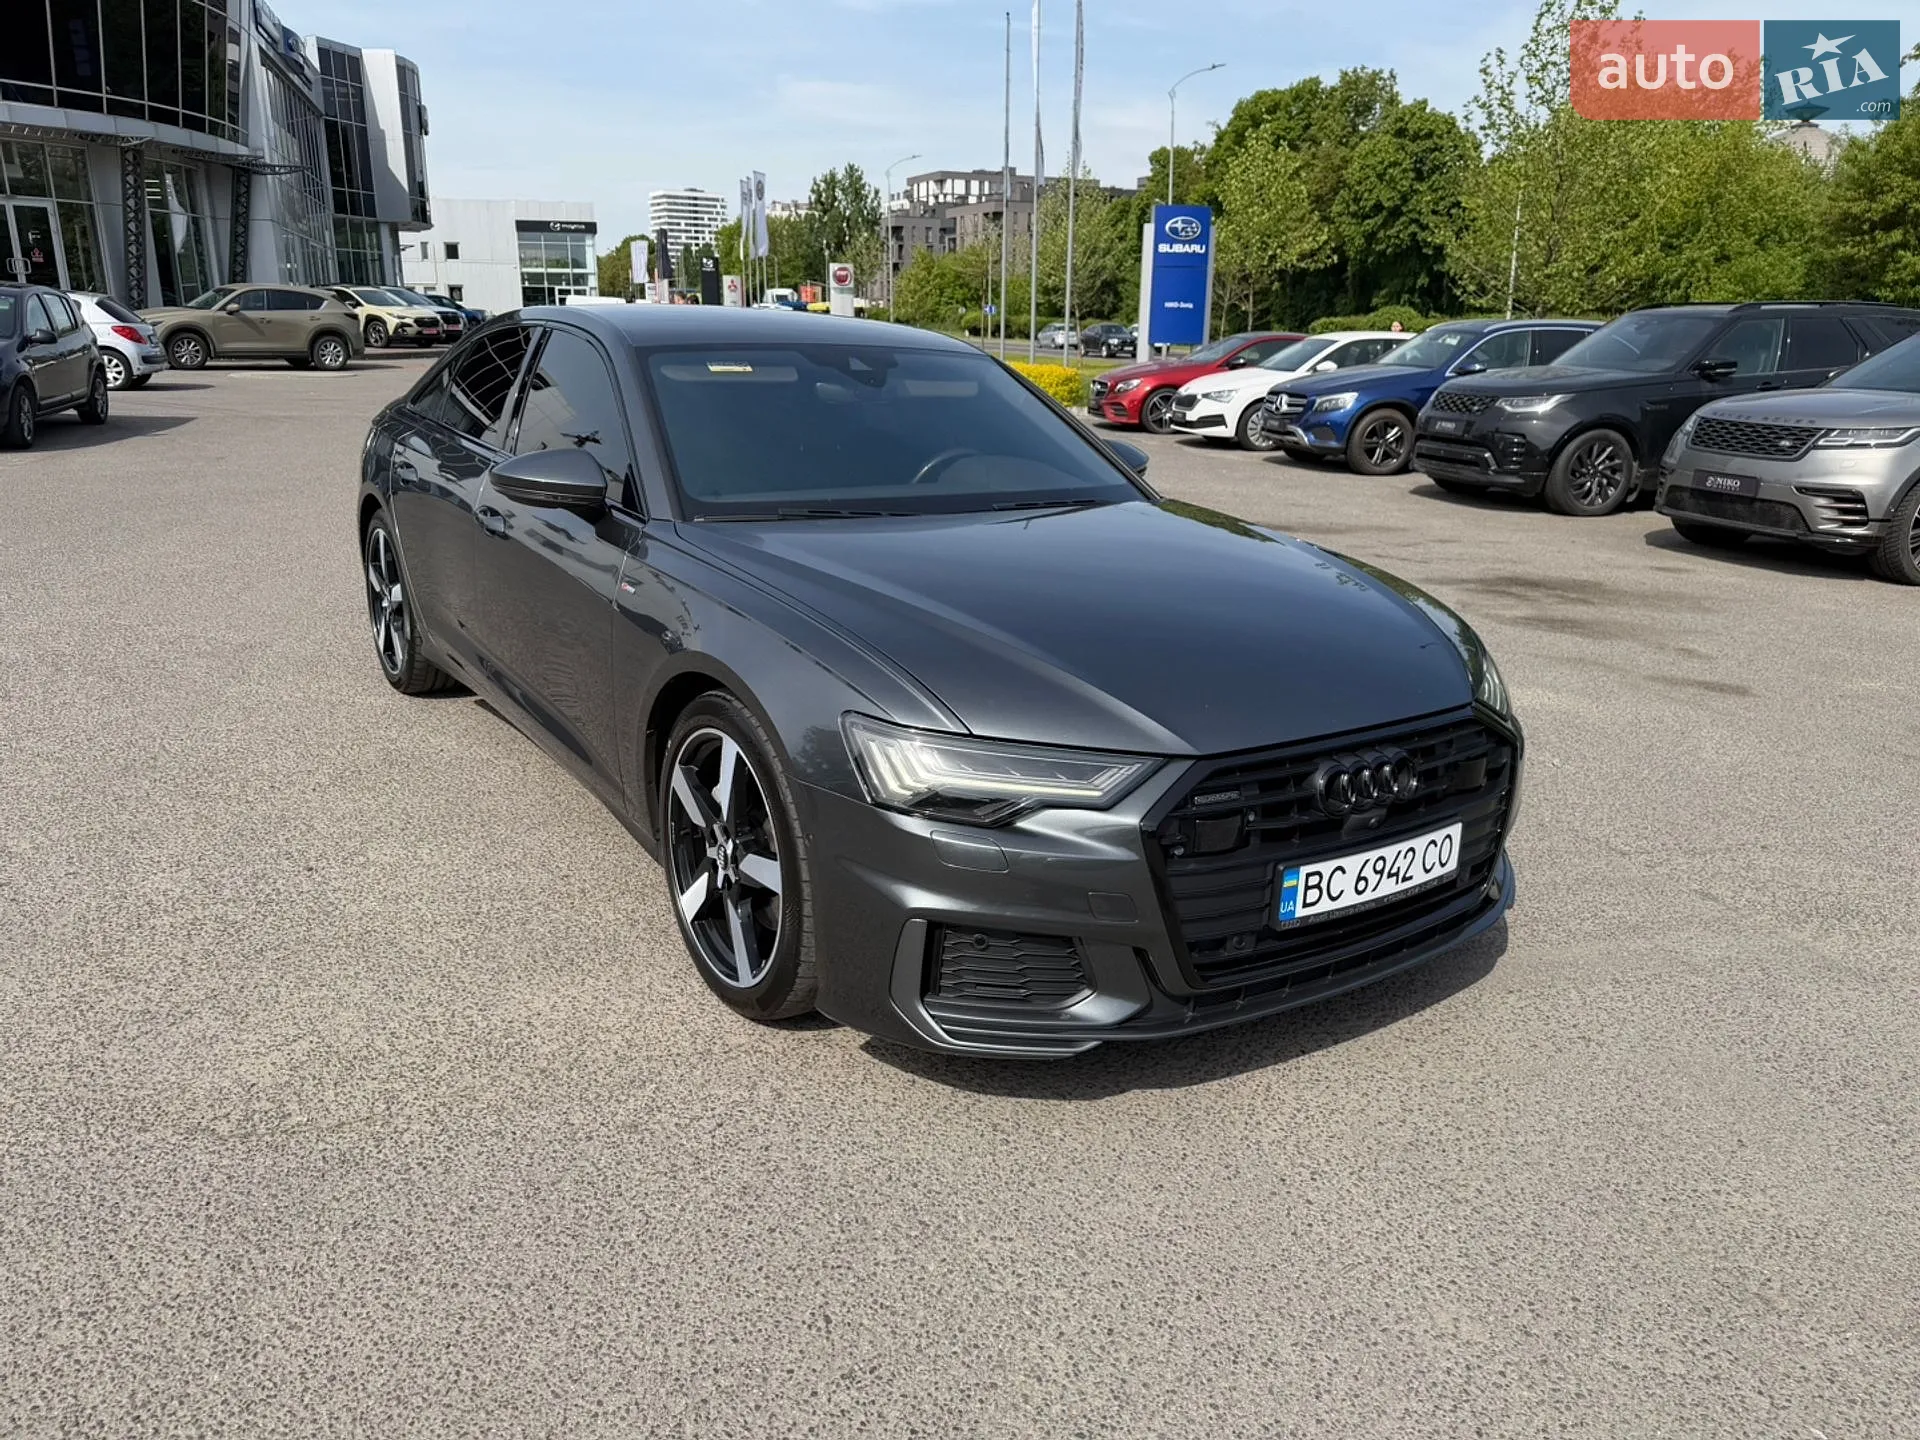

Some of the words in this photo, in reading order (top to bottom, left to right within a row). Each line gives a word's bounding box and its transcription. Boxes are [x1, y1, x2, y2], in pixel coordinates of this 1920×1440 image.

[1158, 243, 1206, 254] SUBARU
[1302, 865, 1347, 909] BC
[1354, 846, 1416, 896] 6942
[1422, 833, 1453, 875] CO
[1280, 901, 1295, 914] UA
